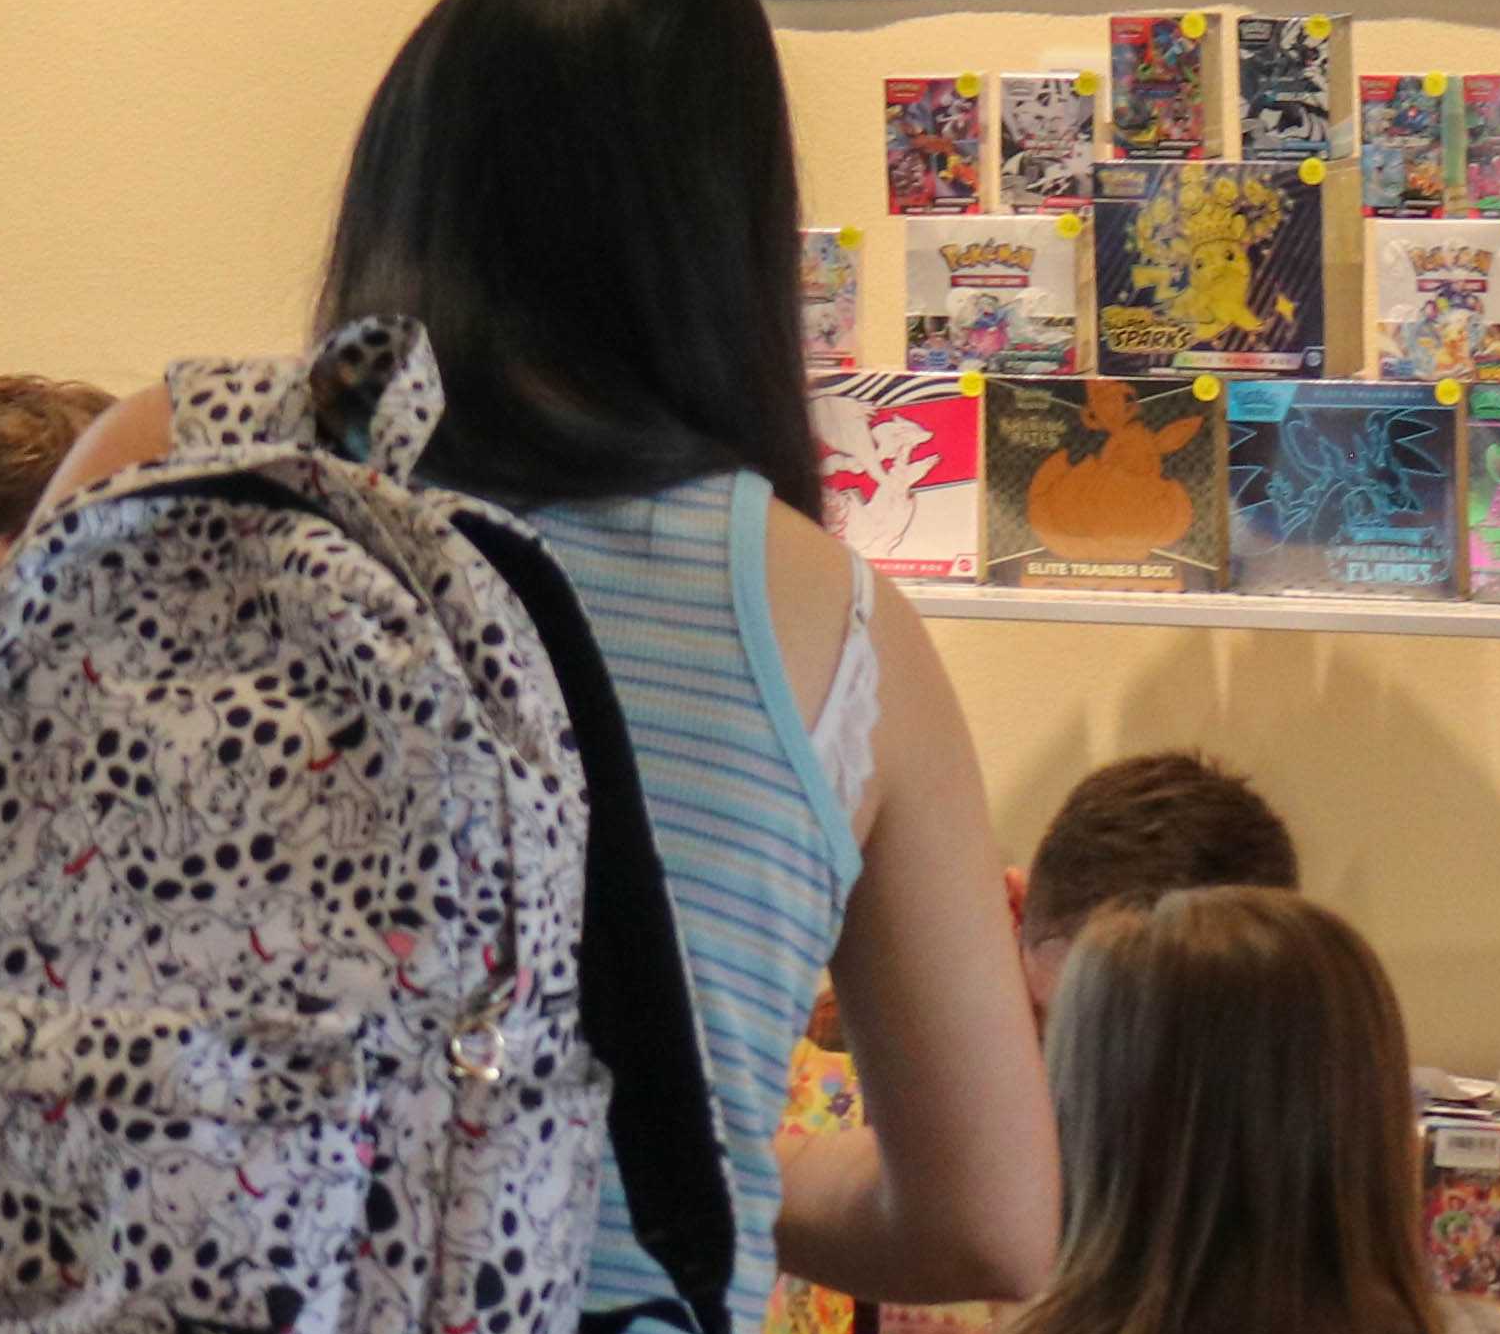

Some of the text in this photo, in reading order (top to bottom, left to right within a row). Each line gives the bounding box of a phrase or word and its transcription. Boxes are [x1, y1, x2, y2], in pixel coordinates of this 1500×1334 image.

[1113, 326, 1195, 351] SPARKS
[1027, 562, 1174, 578] ELITE TRAINER BOX
